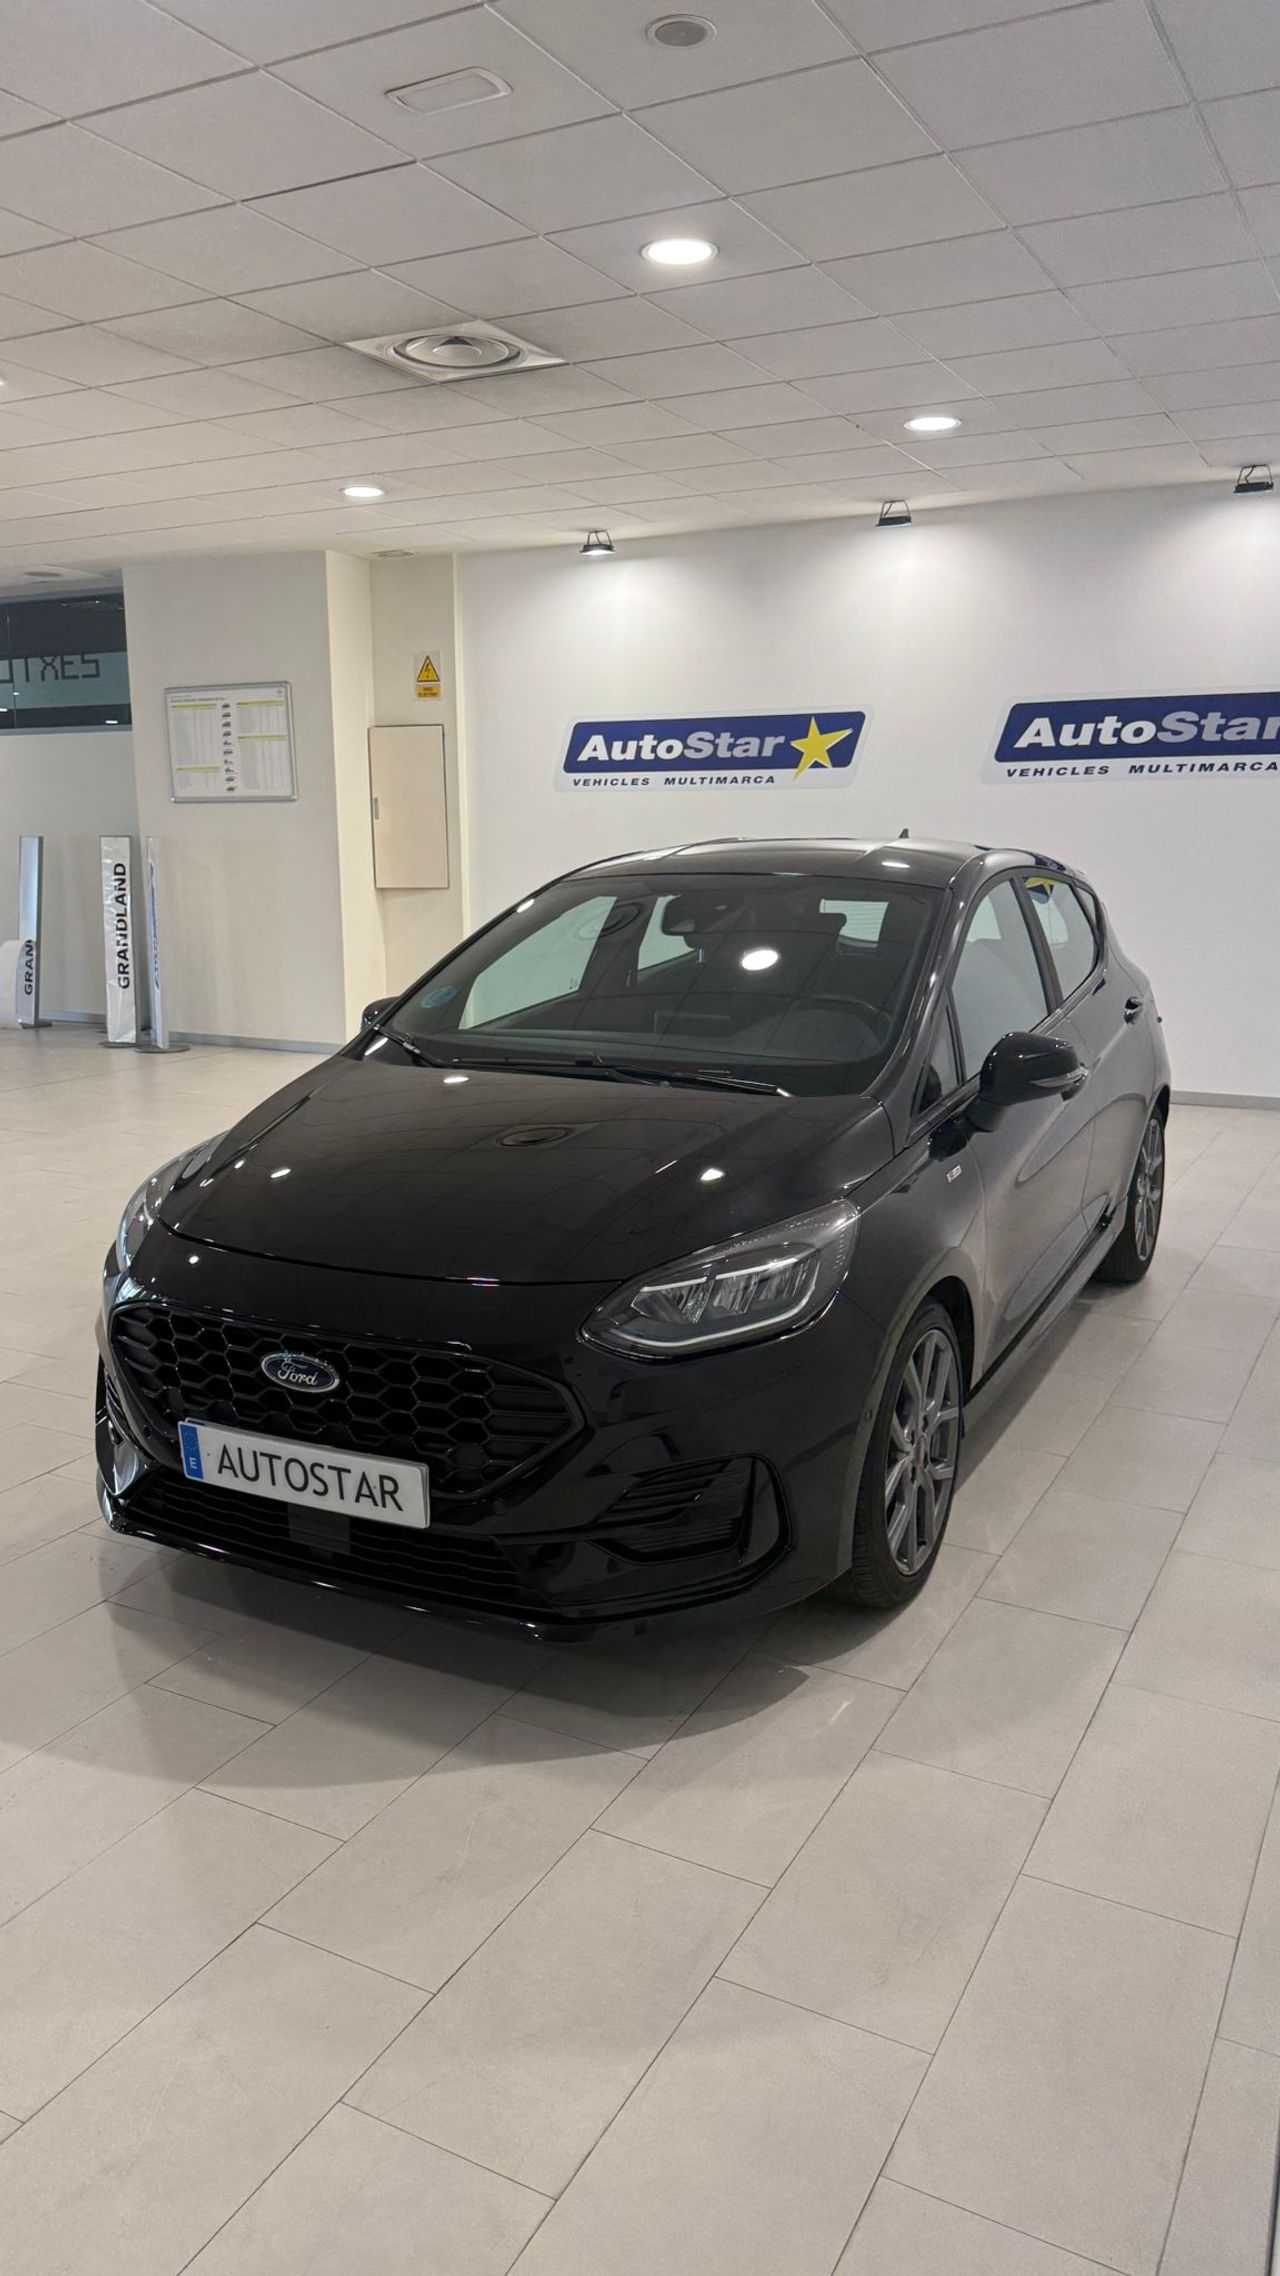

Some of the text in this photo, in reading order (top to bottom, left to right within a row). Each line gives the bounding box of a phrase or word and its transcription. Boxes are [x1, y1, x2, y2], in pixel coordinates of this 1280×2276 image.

[1014, 711, 1280, 748] AutoStar
[577, 732, 785, 762] AutoStar
[573, 775, 775, 787] VEHICLES MULTIMARCA
[1007, 762, 1278, 777] VEHICLES MULTIMARCA
[114, 863, 131, 989] GRANDLAND
[277, 1361, 318, 1386] Ford
[189, 1444, 403, 1511] E AUTOSTAR
